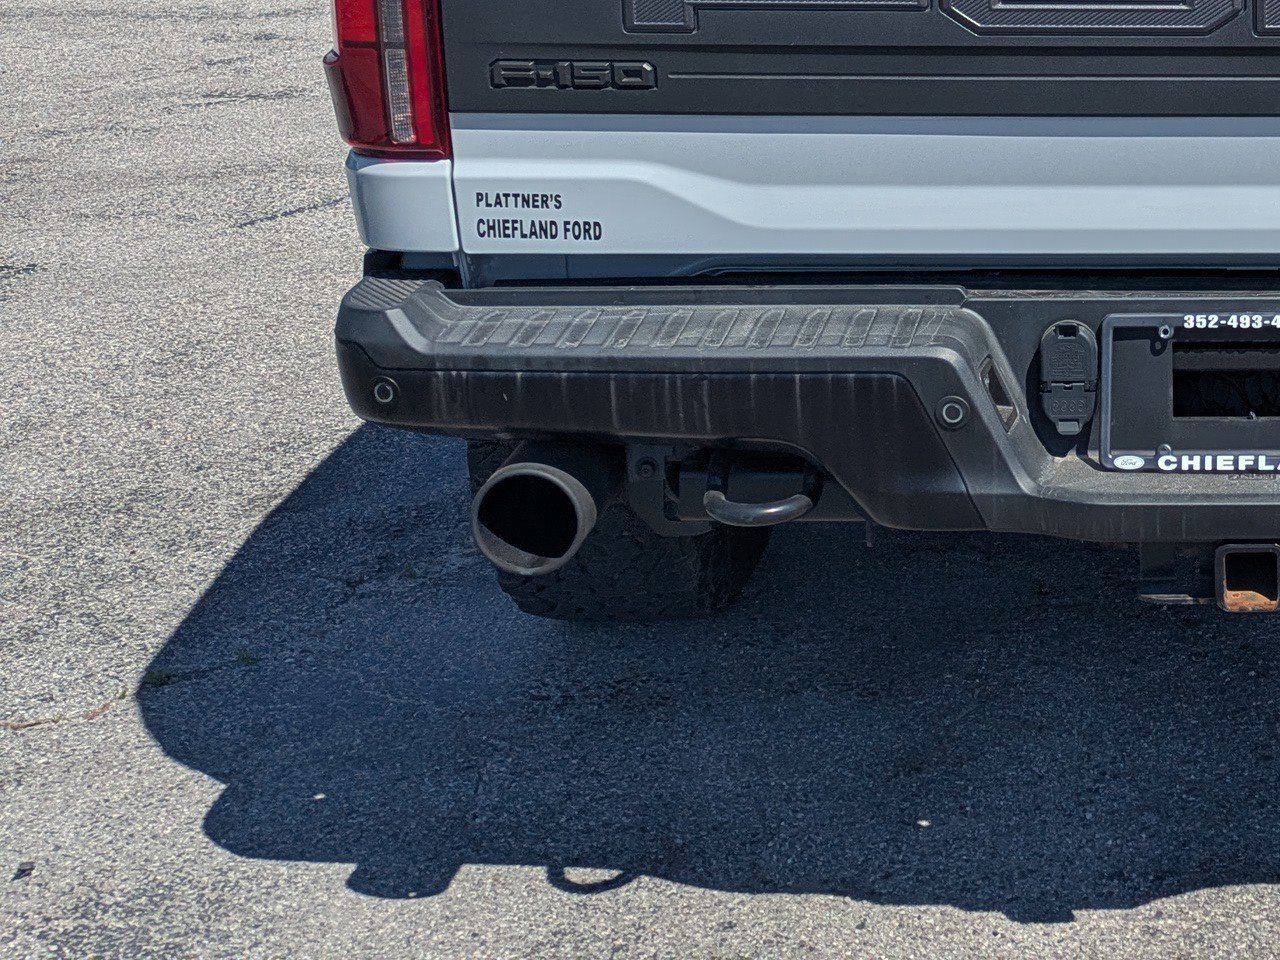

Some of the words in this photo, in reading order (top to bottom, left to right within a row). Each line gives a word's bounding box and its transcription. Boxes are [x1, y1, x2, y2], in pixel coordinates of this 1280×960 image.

[489, 58, 658, 90] F-150
[475, 192, 562, 210] PLATTNER'S
[476, 218, 558, 240] CHIEFLAND
[563, 220, 602, 241] FORD
